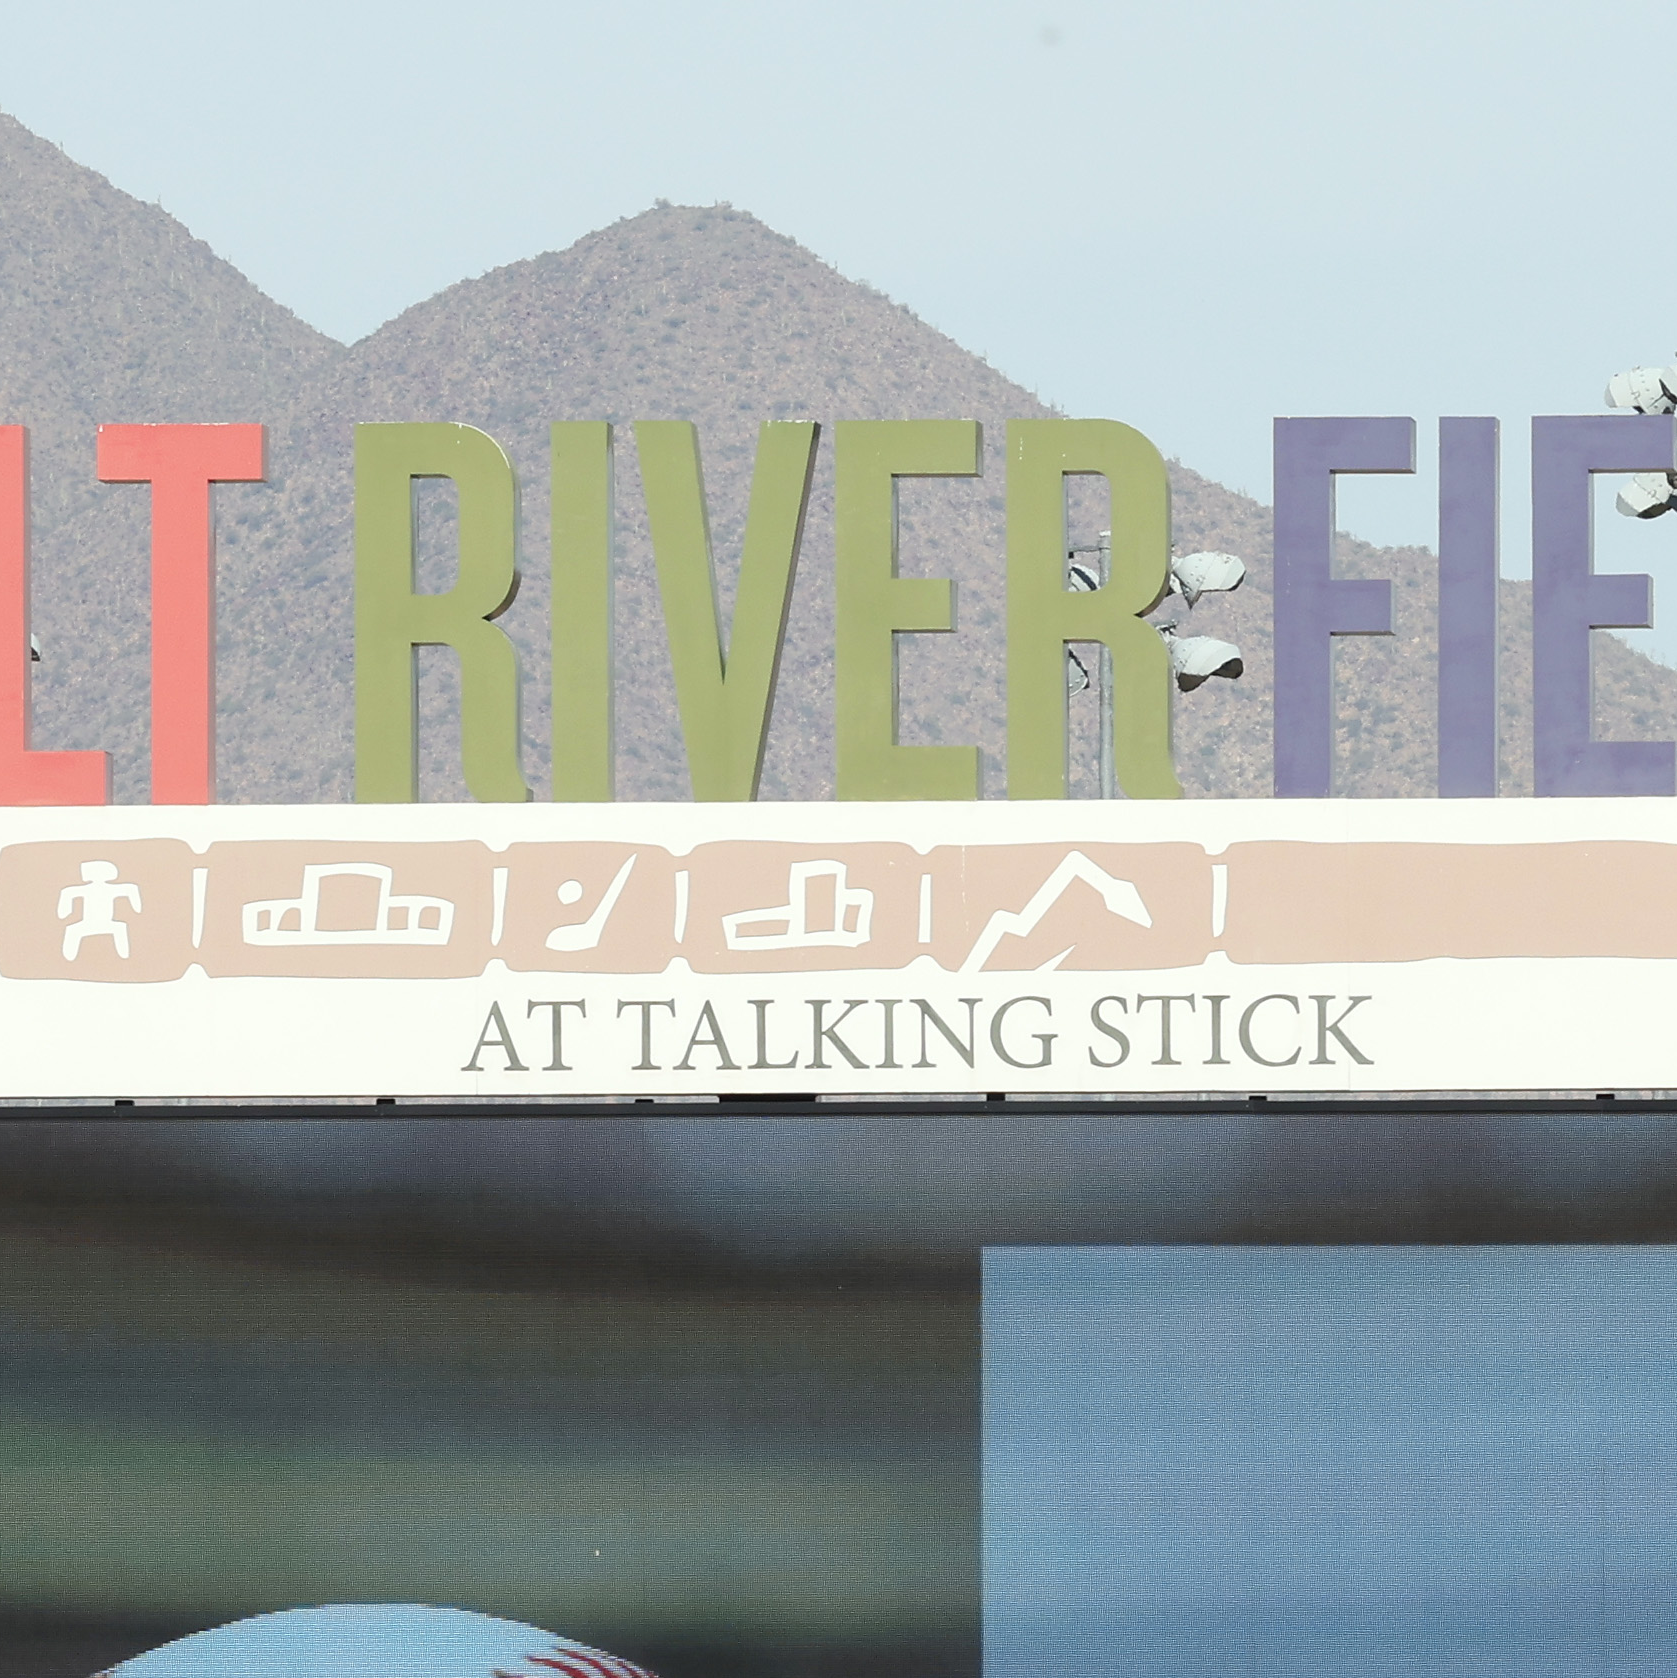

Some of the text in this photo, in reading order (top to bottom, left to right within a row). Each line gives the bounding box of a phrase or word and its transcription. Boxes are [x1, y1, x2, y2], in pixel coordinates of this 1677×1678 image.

[354, 418, 1185, 804] RIVER
[460, 993, 1376, 1072] AT TALKING STICK
